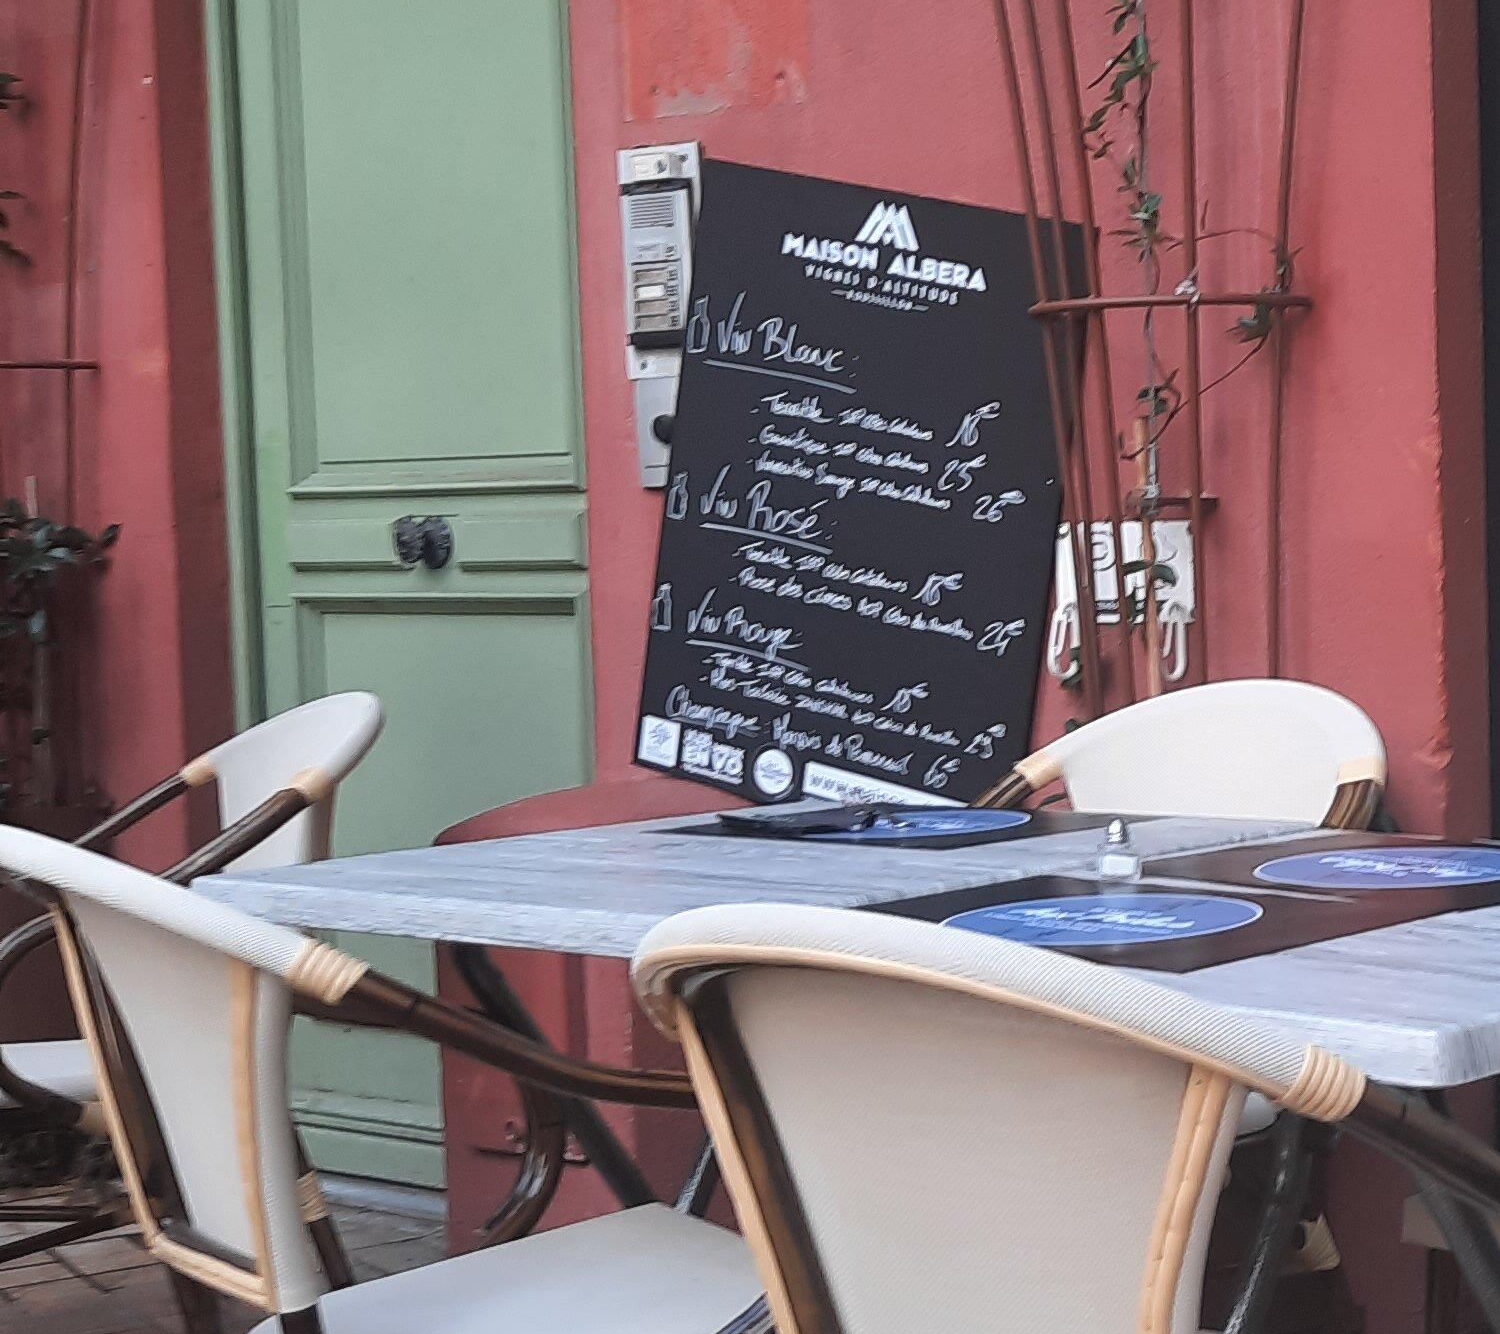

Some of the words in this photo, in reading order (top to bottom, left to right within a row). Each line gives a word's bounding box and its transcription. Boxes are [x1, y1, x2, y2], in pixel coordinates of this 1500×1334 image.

[781, 231, 879, 271] MAISON
[887, 252, 988, 292] ALBERA
[717, 290, 753, 355] Vin
[700, 463, 738, 518] Vin
[687, 587, 722, 634] Vin
